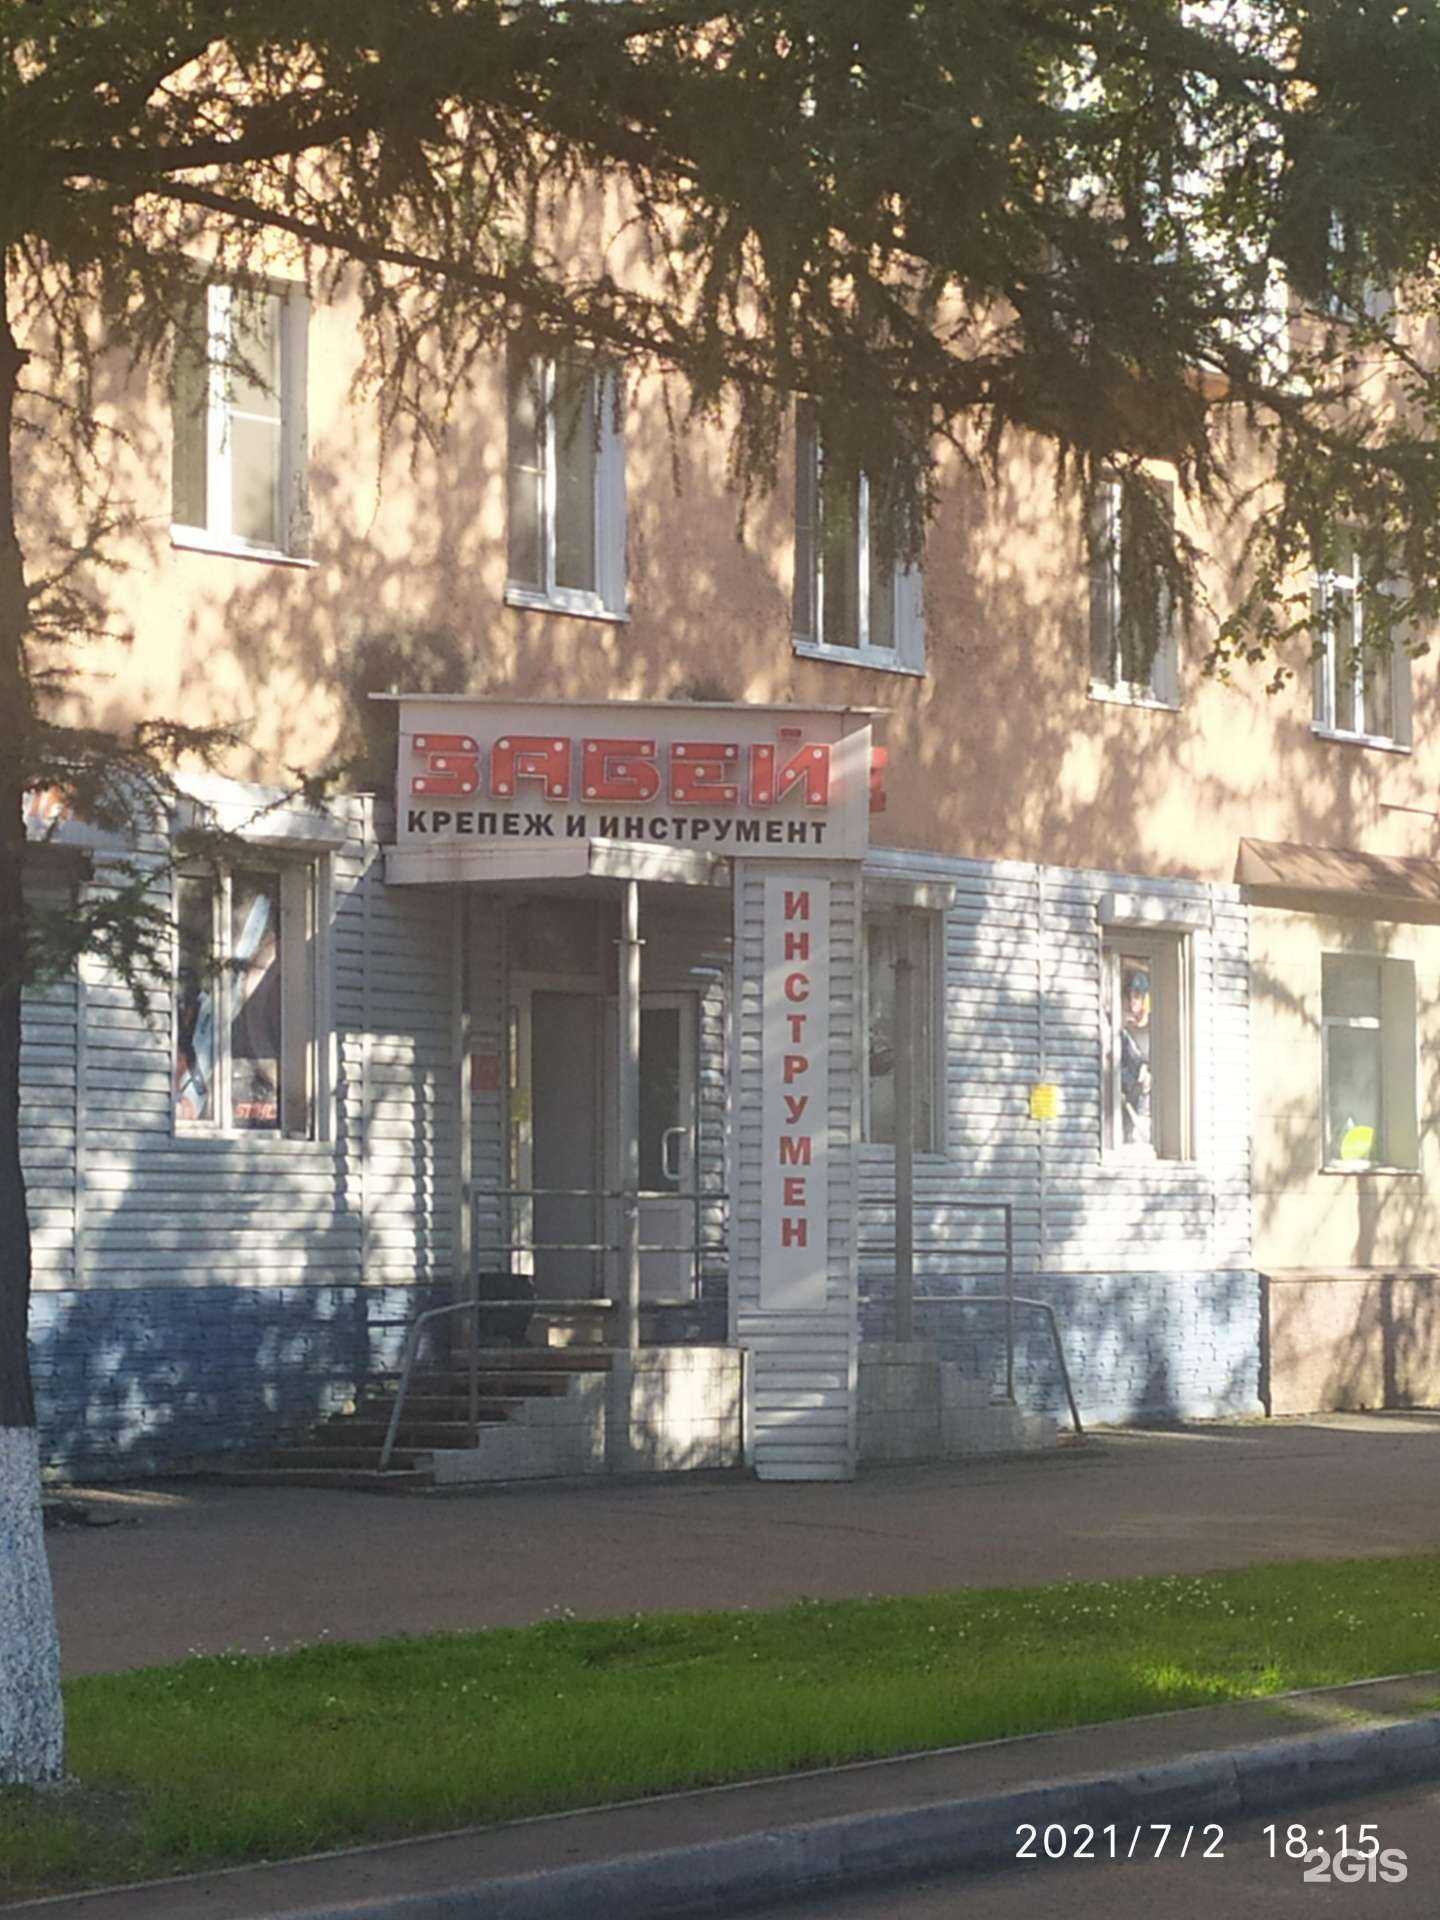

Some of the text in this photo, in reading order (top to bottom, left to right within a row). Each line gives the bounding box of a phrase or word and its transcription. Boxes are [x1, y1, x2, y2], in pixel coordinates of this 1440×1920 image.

[411, 728, 831, 807] ЗАБЕЙ
[407, 810, 827, 844] КРЕПЕЖ И ИНСТРУМЕНТ
